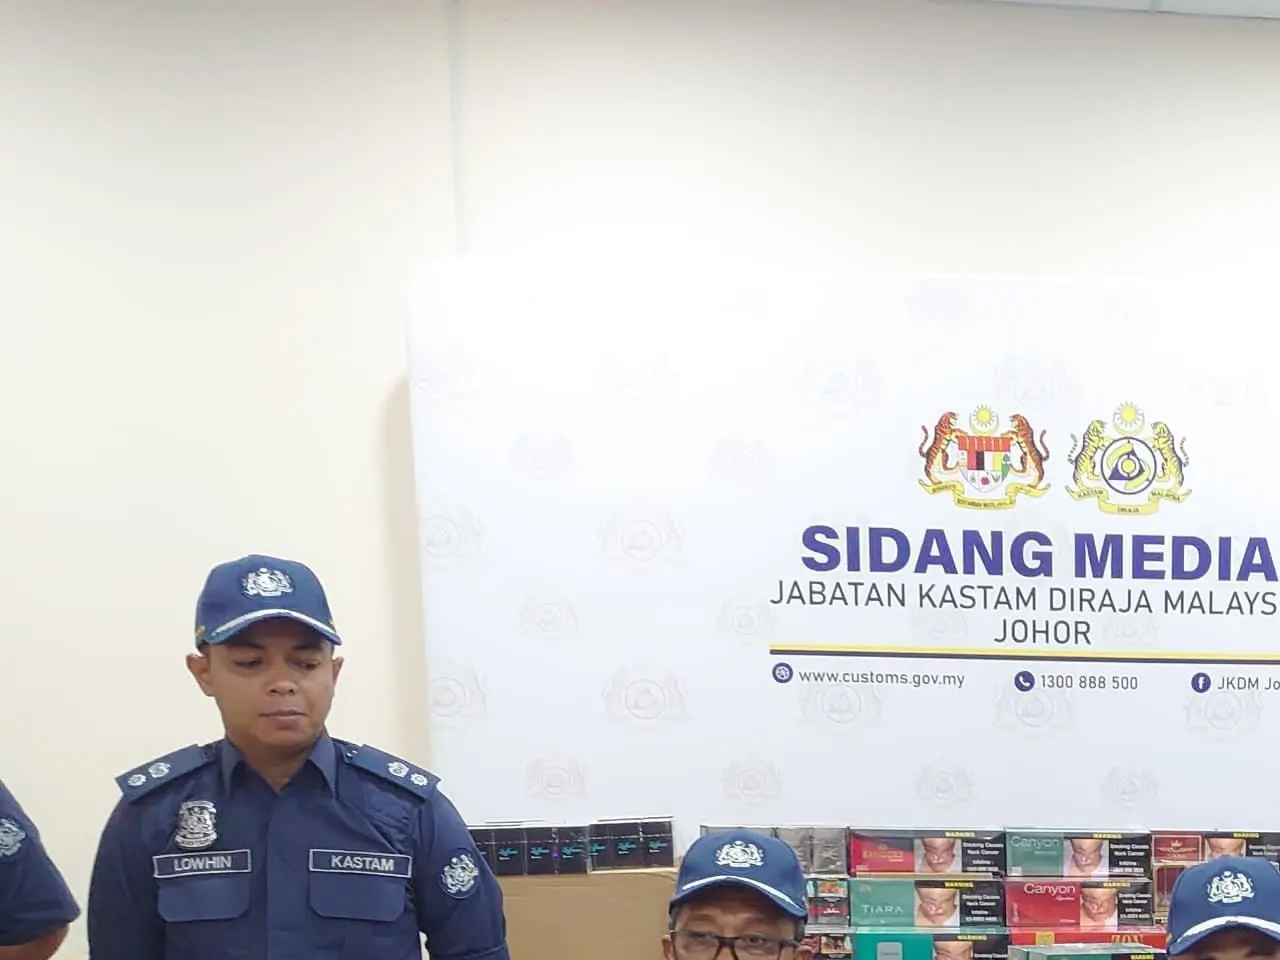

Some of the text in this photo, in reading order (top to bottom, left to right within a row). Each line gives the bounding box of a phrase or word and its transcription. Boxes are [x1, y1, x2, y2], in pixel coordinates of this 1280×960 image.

[801, 524, 1279, 582] SIDANG MEDIA
[770, 580, 906, 608] JABATAN
[919, 583, 1037, 611] KASTAM
[1049, 587, 1152, 614] DIRAJA
[994, 619, 1092, 645] JOHOR
[798, 668, 965, 689] www.customs.gov.my
[1040, 674, 1138, 691] 1300 888 500
[1217, 676, 1260, 691] JKDM
[1010, 835, 1060, 849] Canyon
[174, 856, 232, 872] LOWHIN
[331, 855, 395, 872] KASTAM
[1023, 883, 1076, 896] Canyon
[861, 904, 904, 914] TIARA
